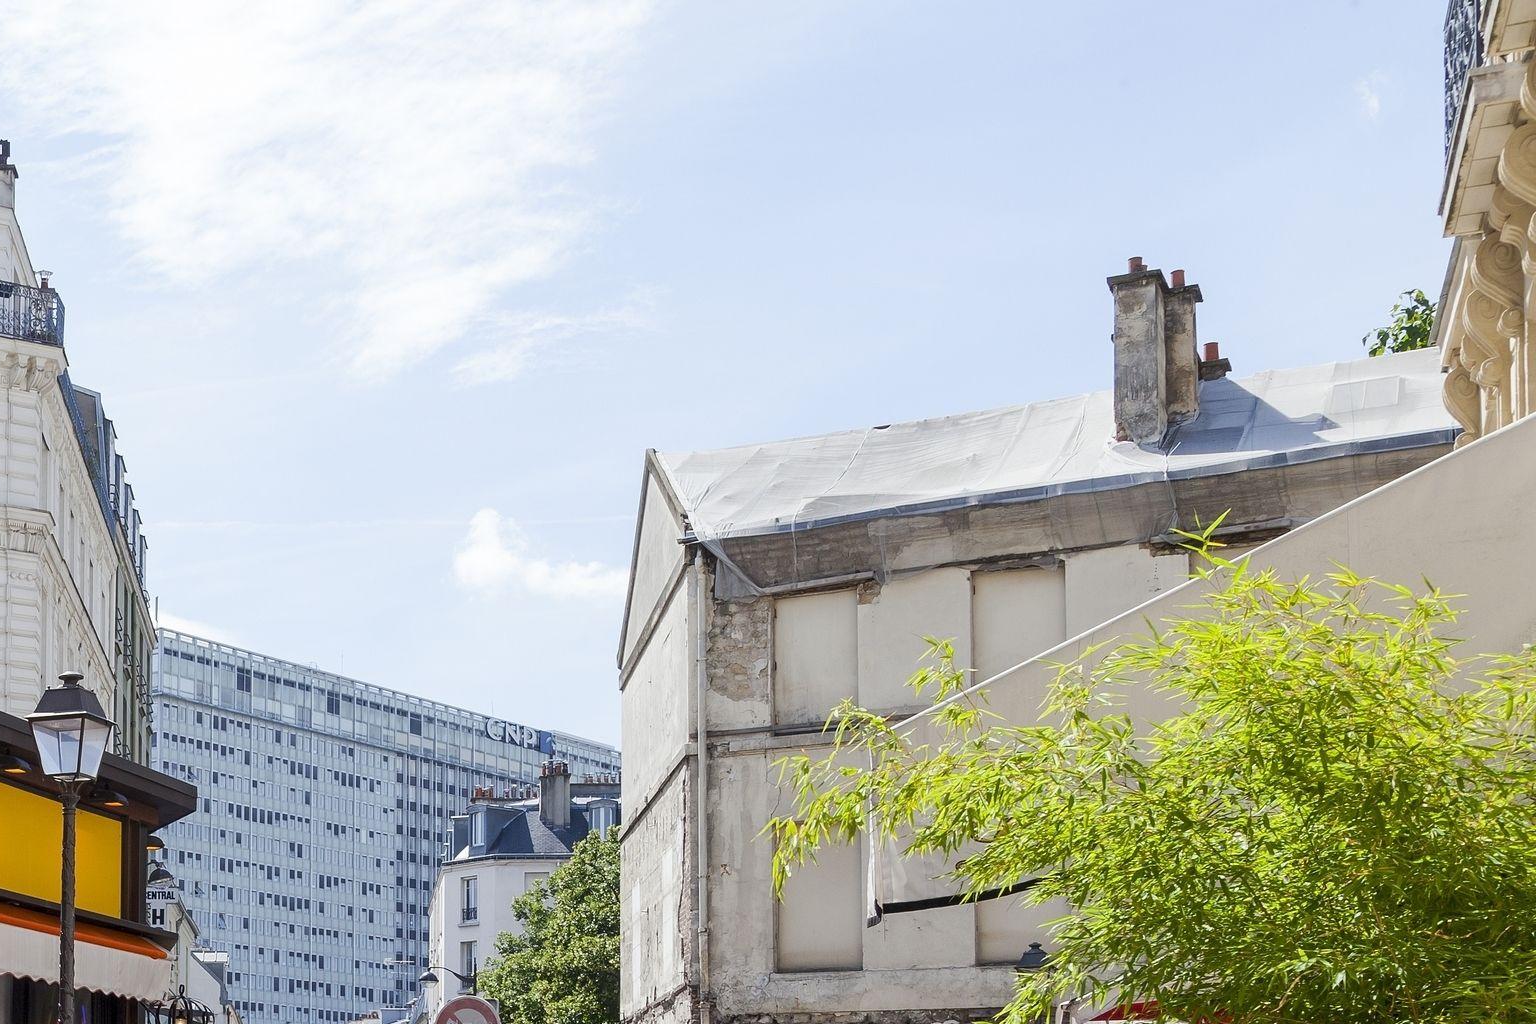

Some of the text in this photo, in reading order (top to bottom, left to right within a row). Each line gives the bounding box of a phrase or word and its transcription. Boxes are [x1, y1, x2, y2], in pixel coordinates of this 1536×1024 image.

[486, 717, 538, 749] CNP
[146, 890, 175, 900] ENTRAL
[152, 908, 164, 925] H
